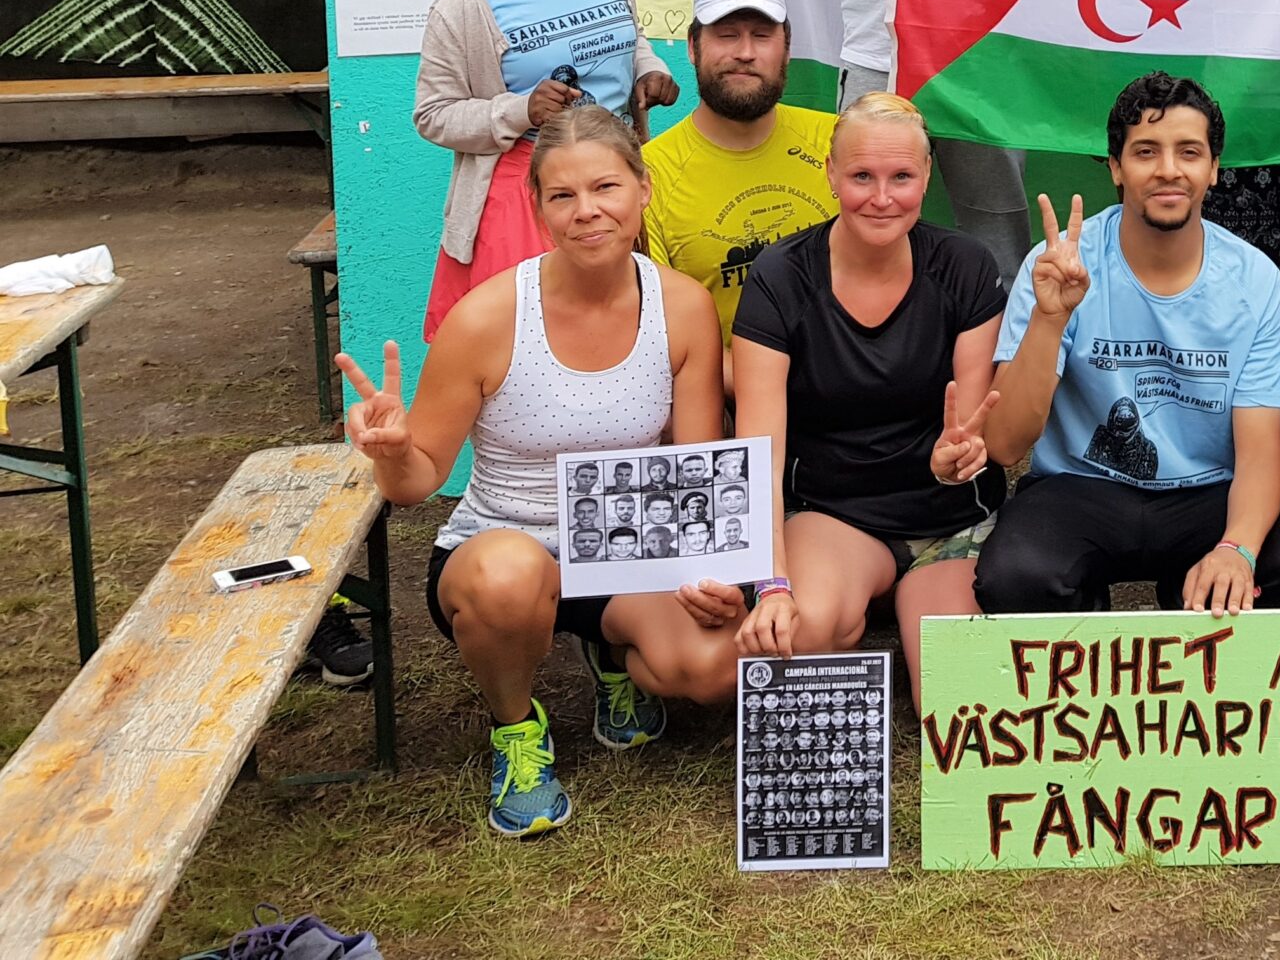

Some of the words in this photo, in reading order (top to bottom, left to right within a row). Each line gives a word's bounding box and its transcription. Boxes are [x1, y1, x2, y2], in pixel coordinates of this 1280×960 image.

[509, 18, 569, 44] SAHARA
[522, 36, 548, 52] 2017
[572, 38, 600, 53] SPRING
[600, 33, 615, 45] FÖR
[574, 41, 625, 63] VÄSTSAHARAS
[799, 152, 825, 170] asics
[734, 183, 786, 204] STOCKHOLM
[1146, 343, 1227, 368] MARATHON
[1137, 375, 1167, 387] SPRING
[1136, 388, 1191, 404] VÄSTSAHARAS
[785, 666, 817, 677] CAMPAÑA
[817, 665, 868, 676] INTERNACIONAL
[1010, 626, 1234, 700] FRIHET
[785, 683, 793, 691] EN
[793, 683, 803, 691] LAS
[986, 781, 1277, 860] FÅNGAR
